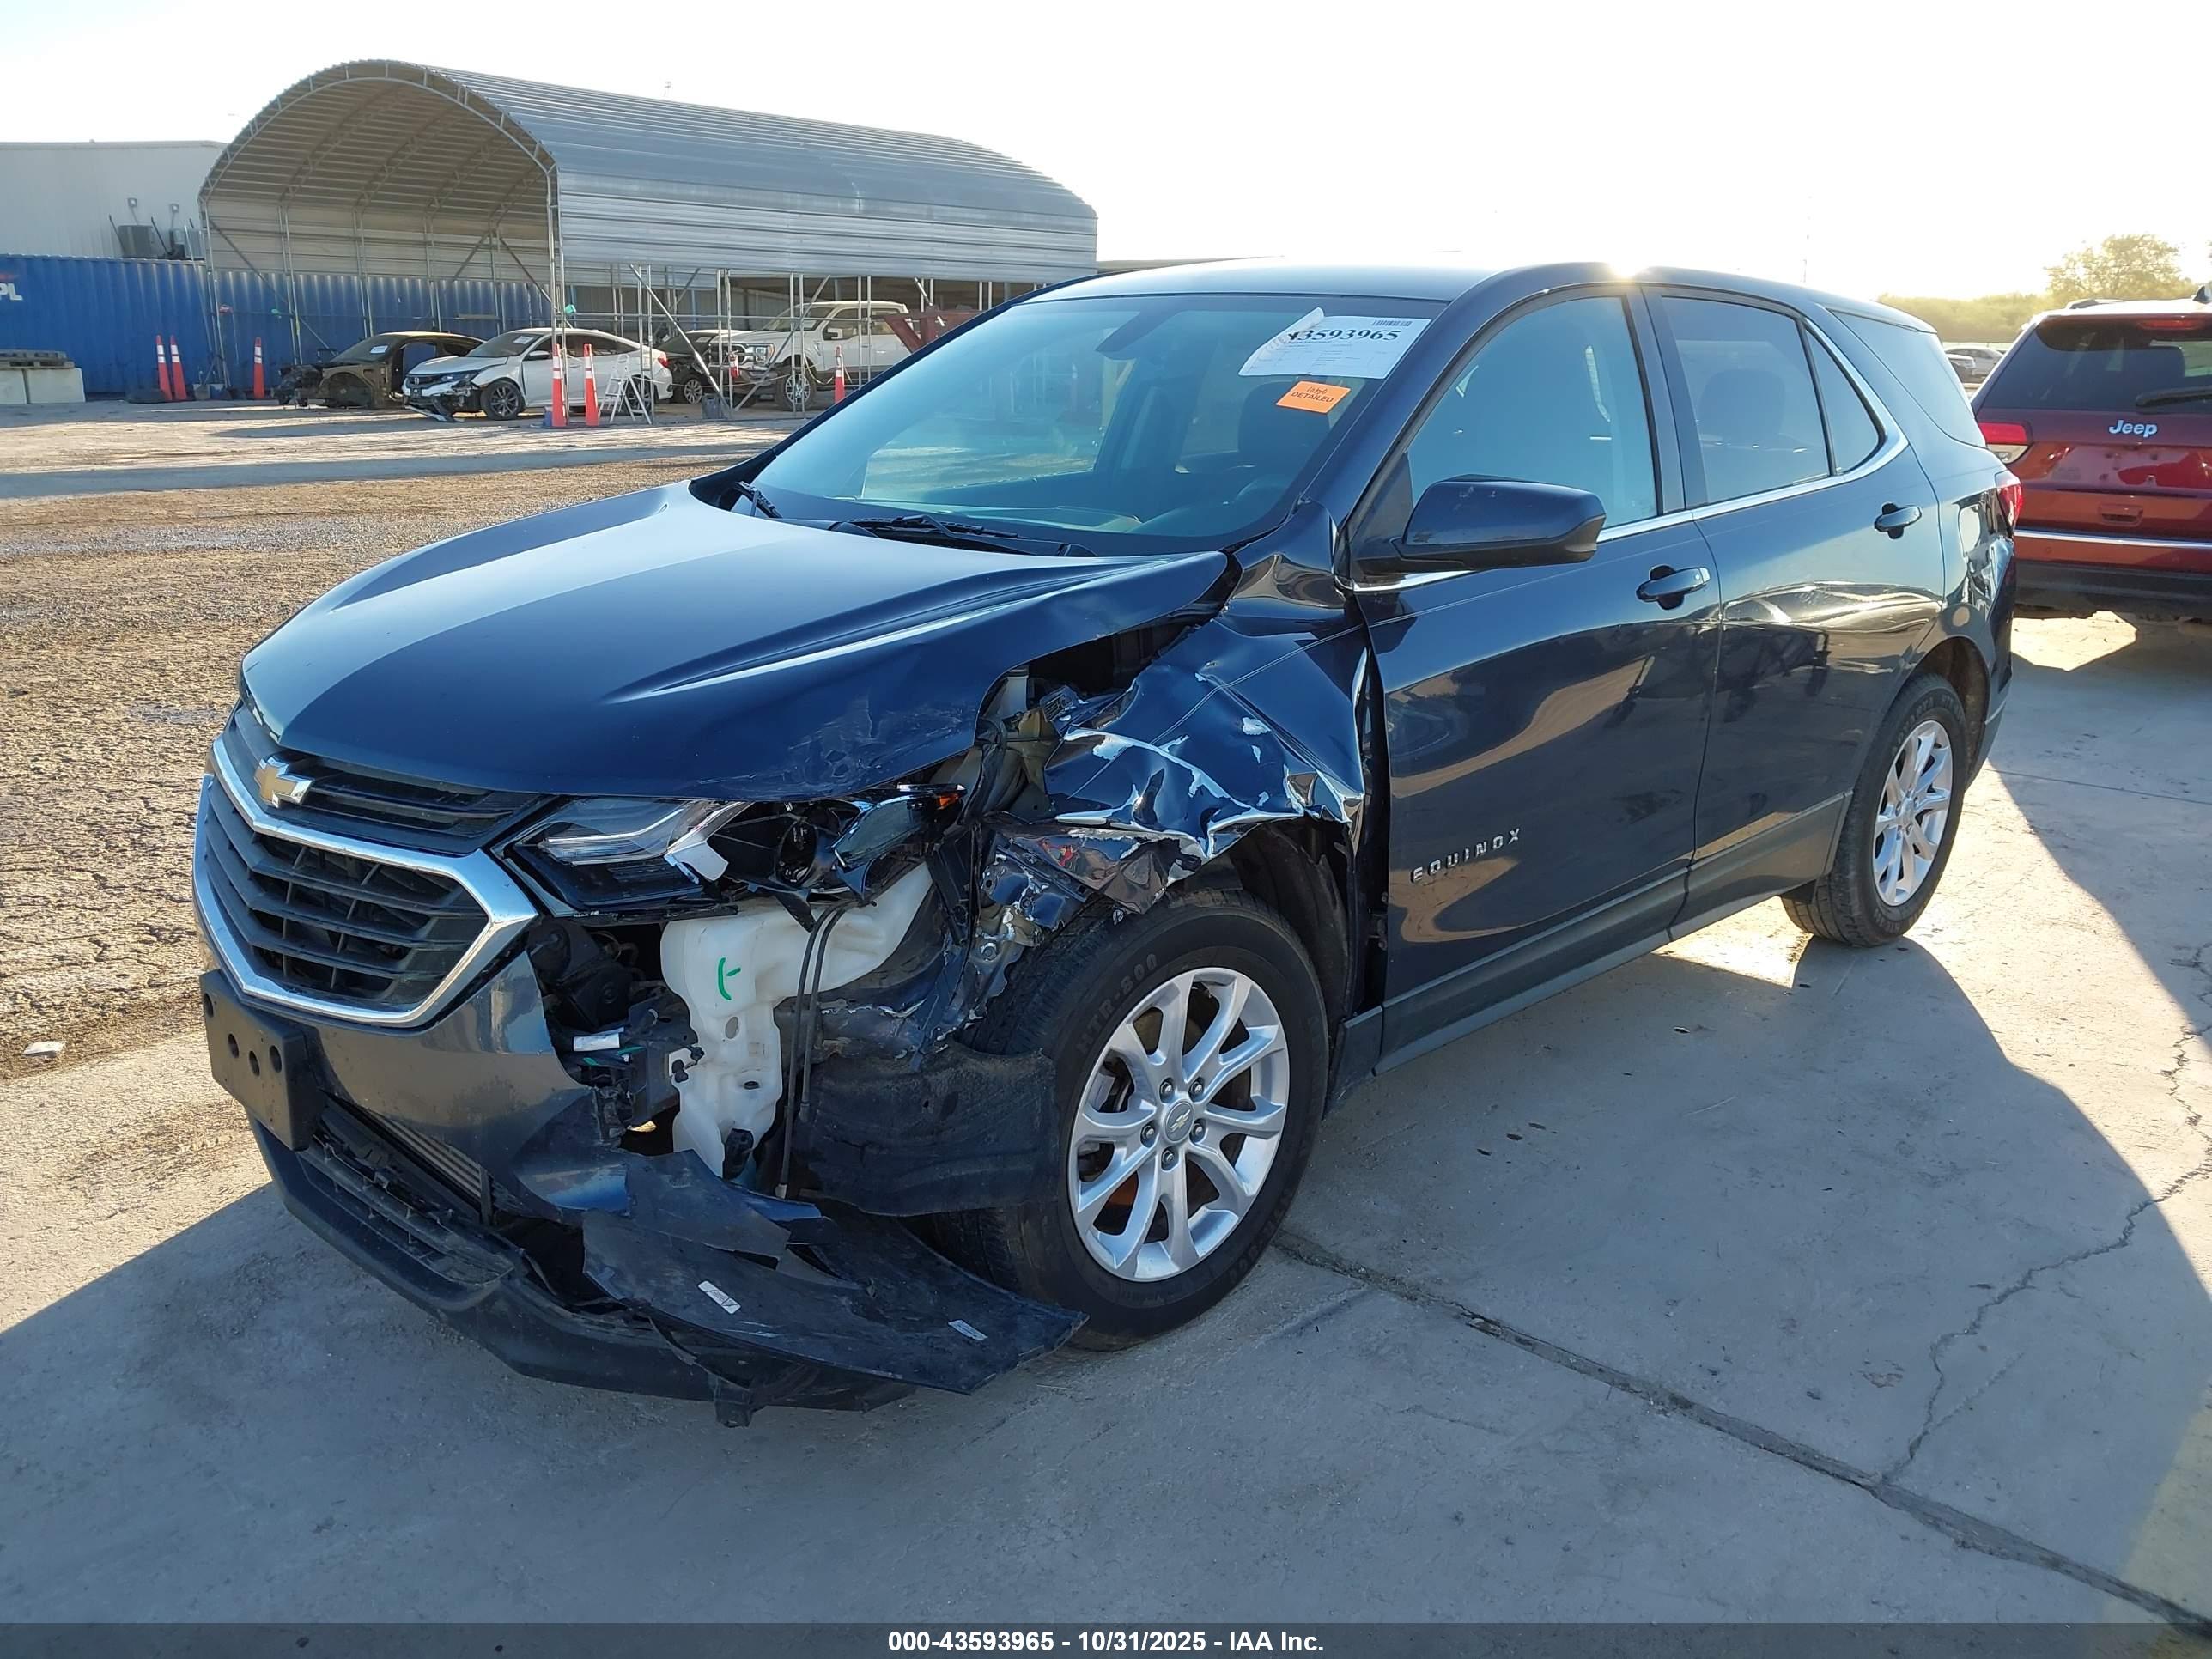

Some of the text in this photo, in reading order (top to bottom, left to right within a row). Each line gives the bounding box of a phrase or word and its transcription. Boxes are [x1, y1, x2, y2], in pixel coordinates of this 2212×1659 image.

[1291, 391, 1334, 403] DETAILED
[2108, 419, 2158, 438] Jeep
[1411, 827, 1521, 883] EQUINOX
[1076, 953, 1157, 1054] HTR-800
